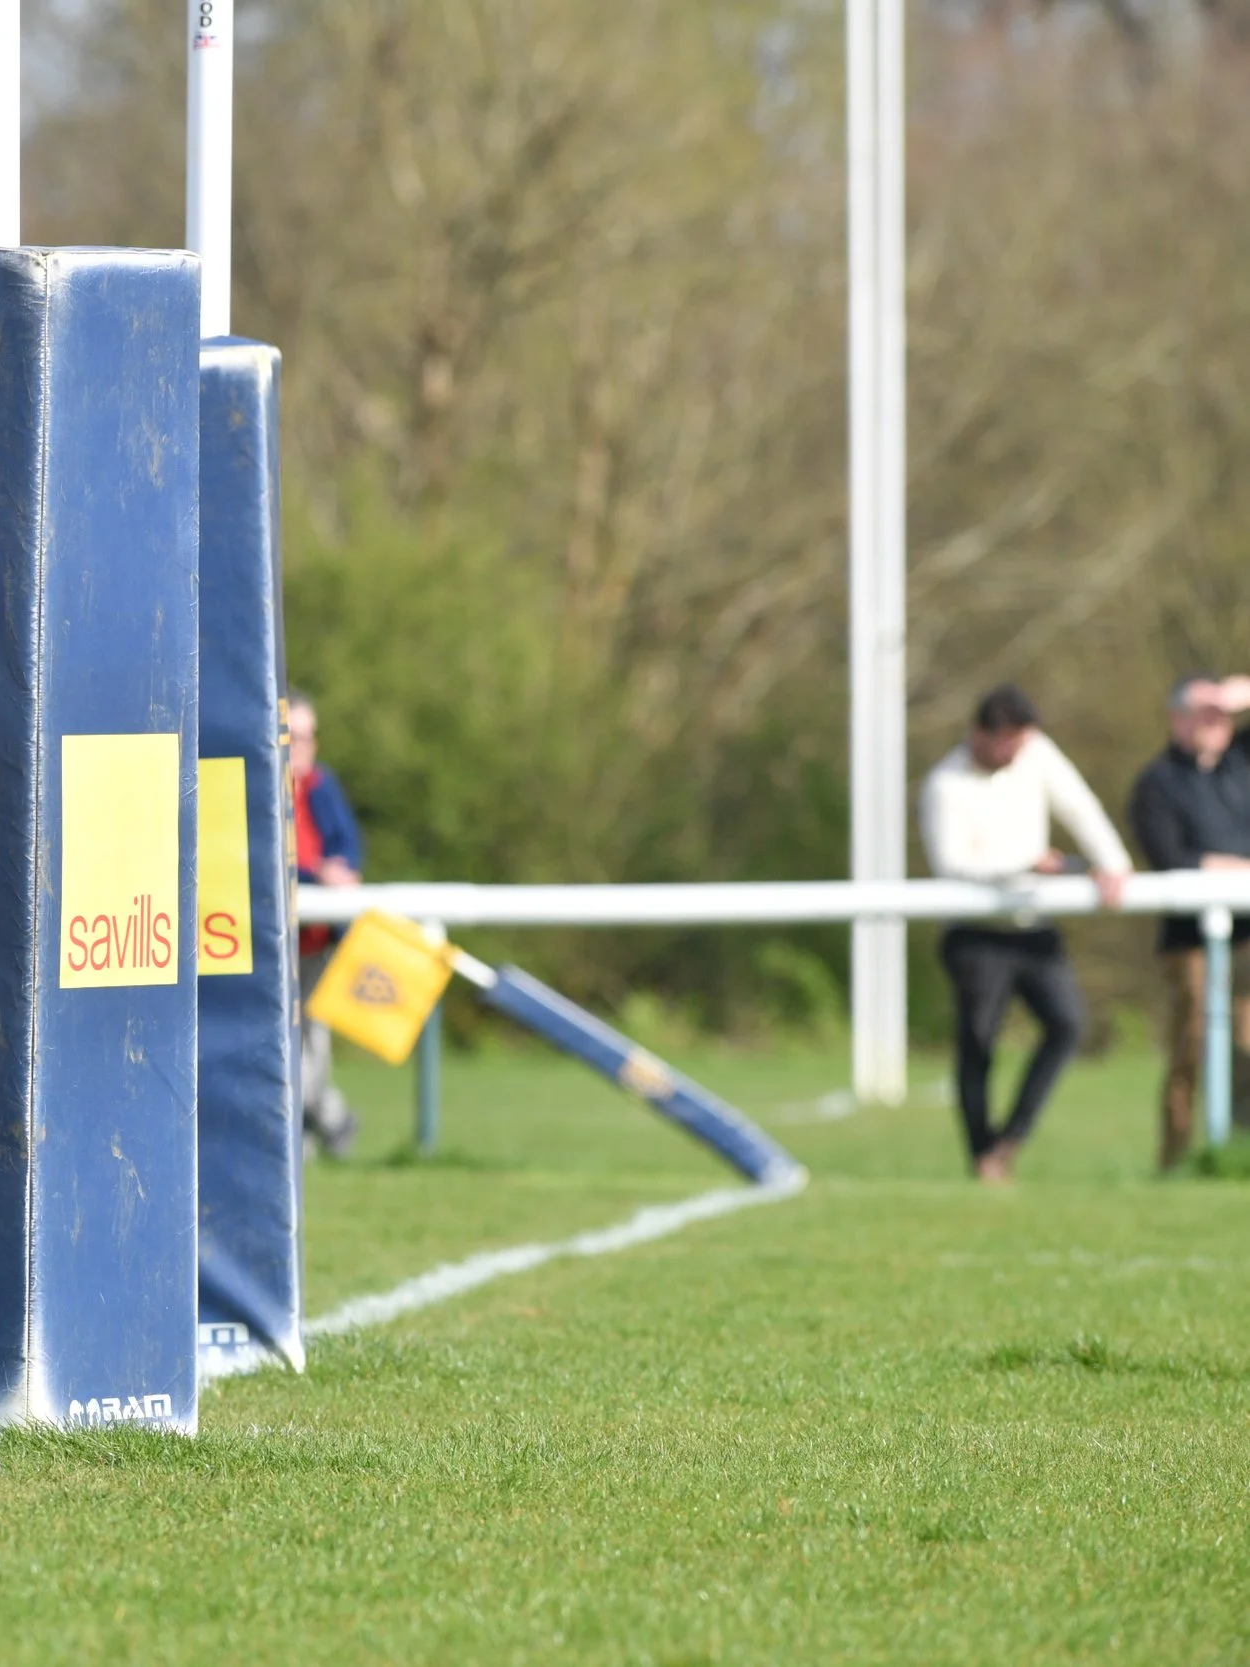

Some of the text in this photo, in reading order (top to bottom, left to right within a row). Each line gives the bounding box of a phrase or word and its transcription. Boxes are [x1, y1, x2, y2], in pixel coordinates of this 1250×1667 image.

[199, 0, 213, 28] OD
[67, 894, 172, 971] savills
[101, 1393, 173, 1421] RAM
